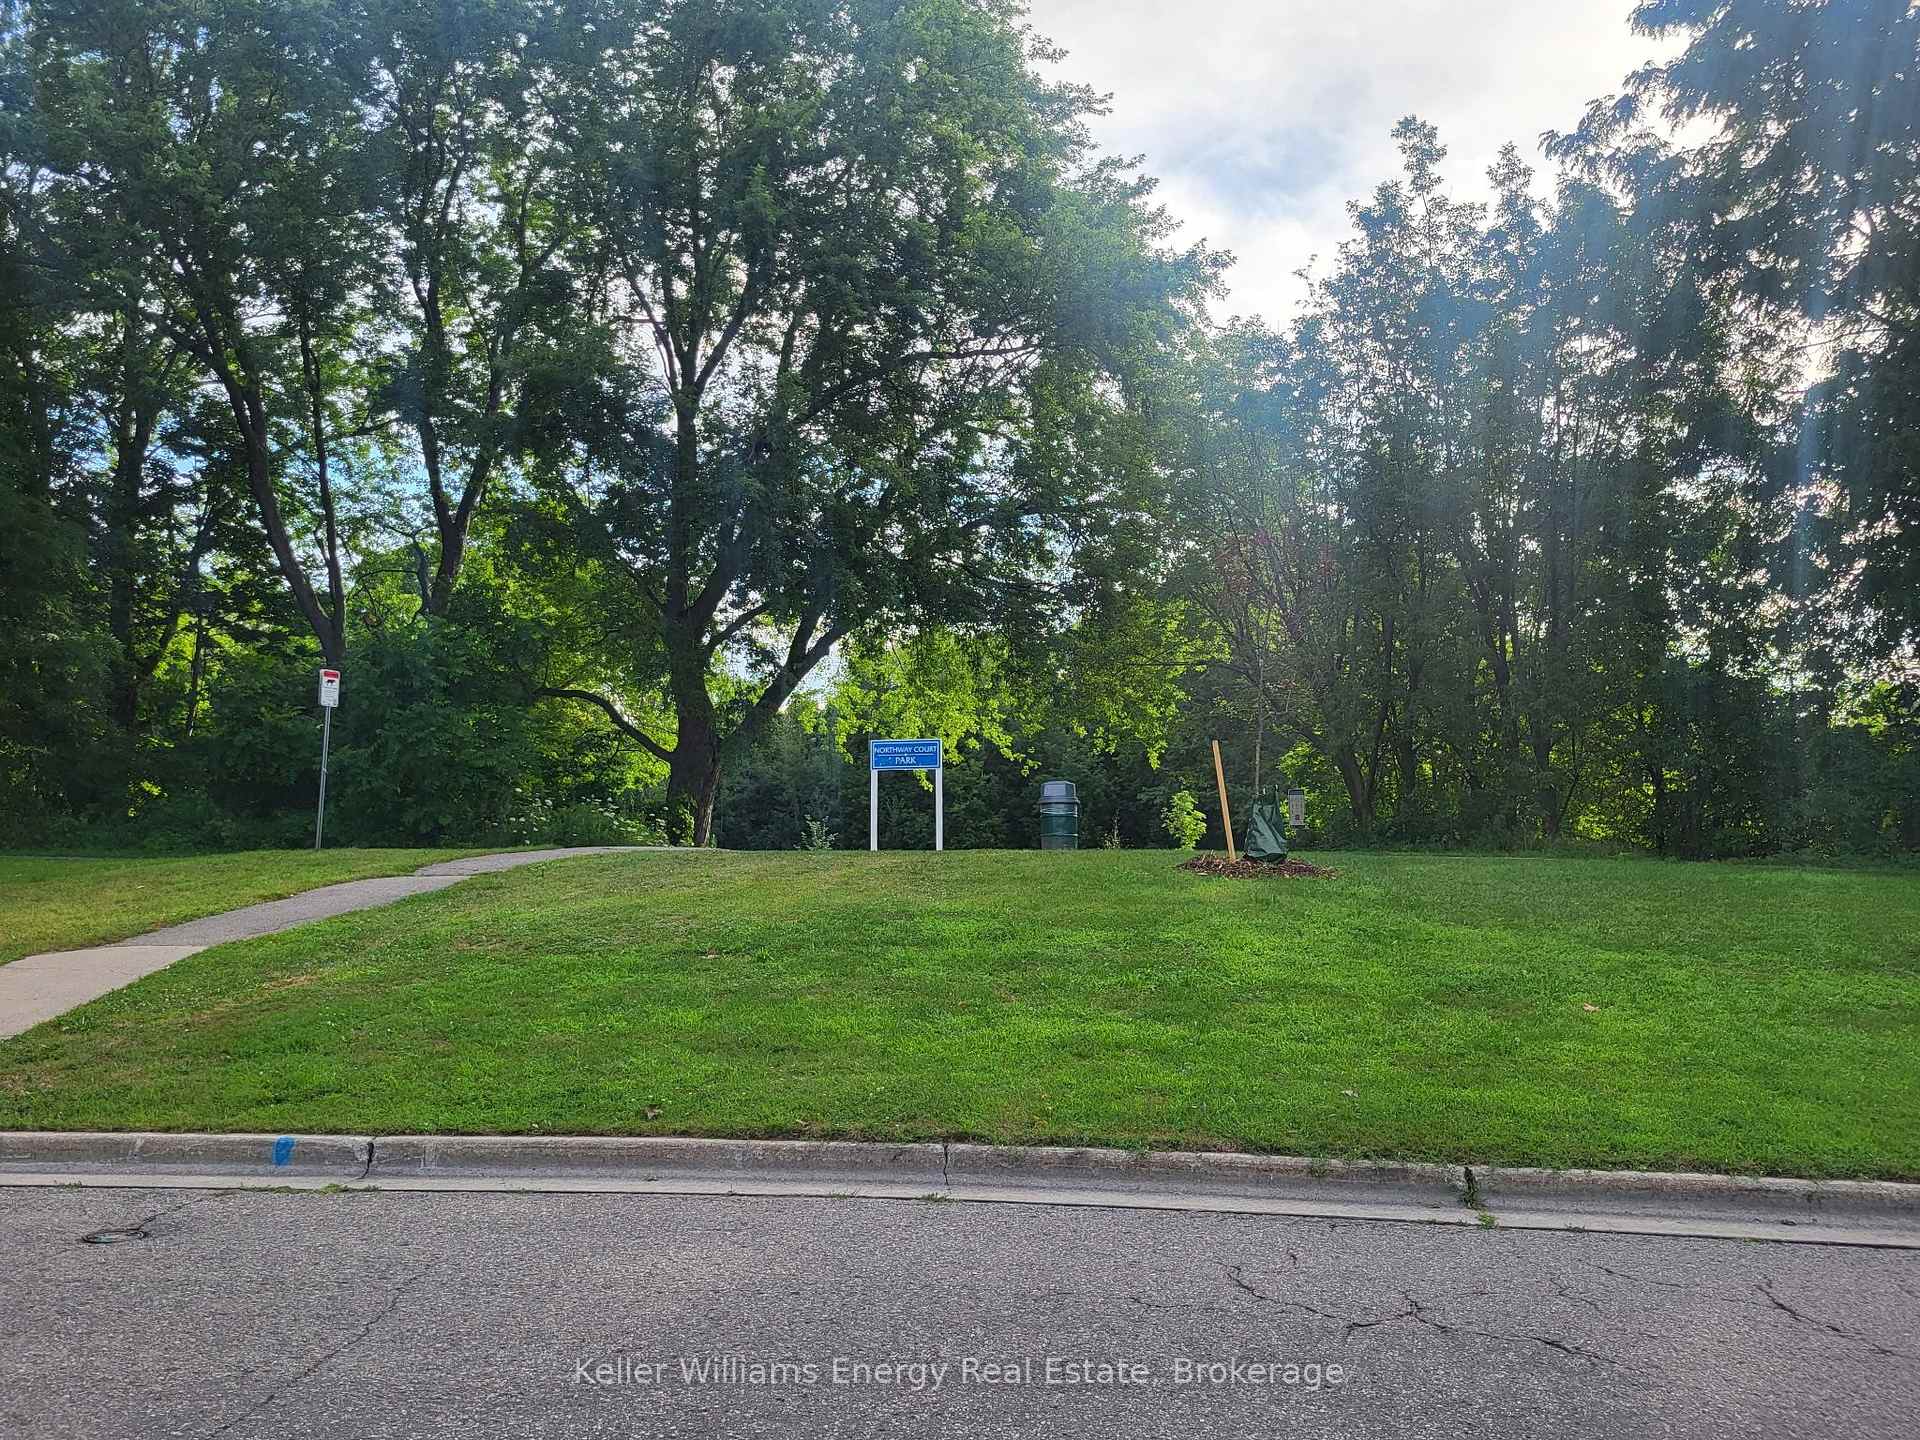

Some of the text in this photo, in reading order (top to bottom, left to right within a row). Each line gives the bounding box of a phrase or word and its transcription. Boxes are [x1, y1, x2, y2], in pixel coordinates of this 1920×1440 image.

[874, 745, 937, 753] NORTHWAY COURT
[895, 756, 917, 764] PARK
